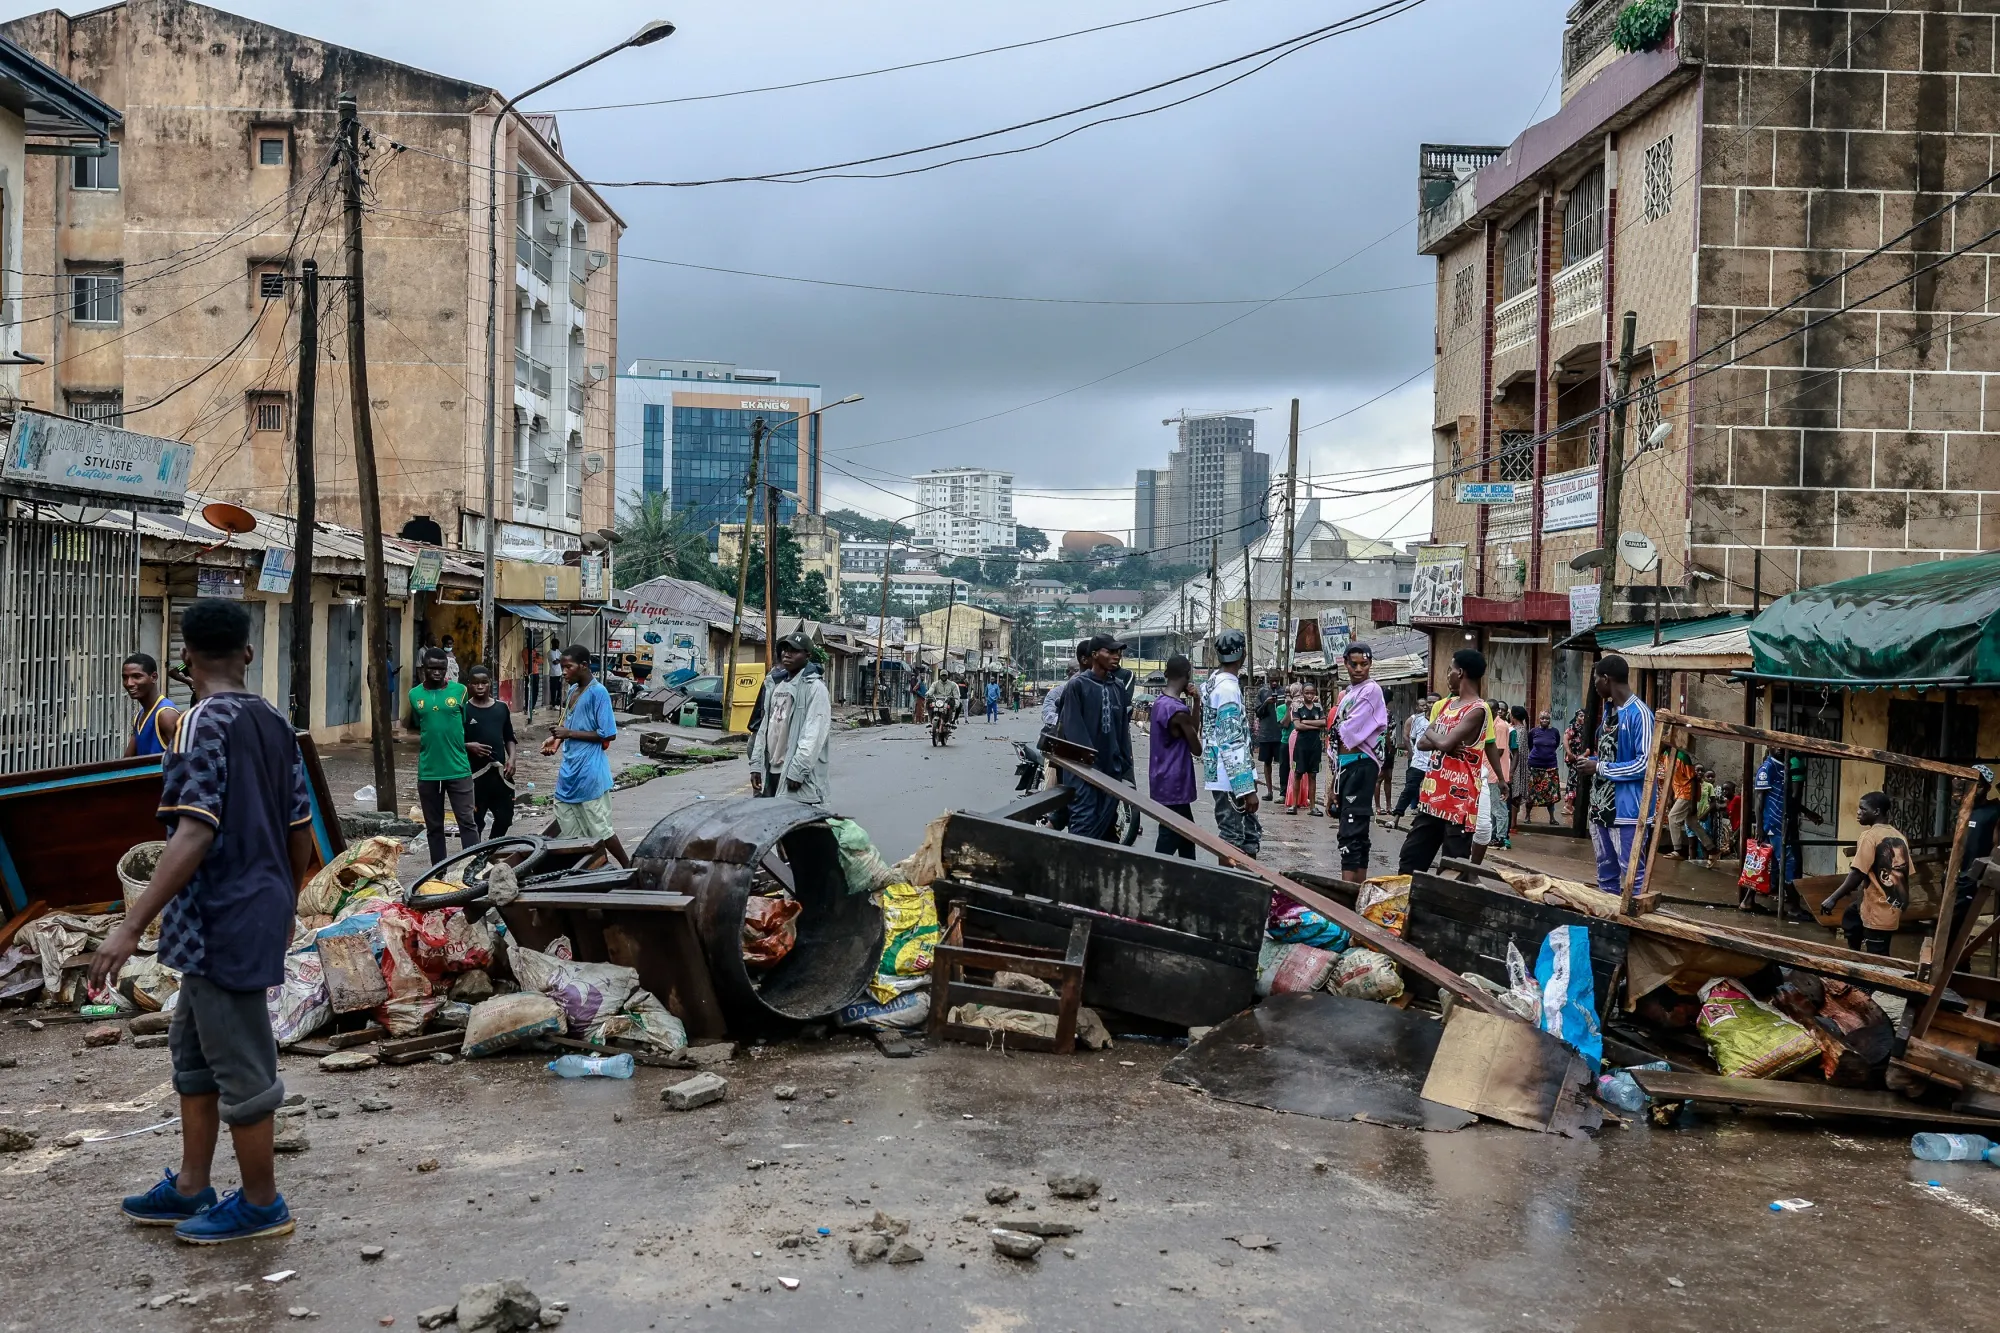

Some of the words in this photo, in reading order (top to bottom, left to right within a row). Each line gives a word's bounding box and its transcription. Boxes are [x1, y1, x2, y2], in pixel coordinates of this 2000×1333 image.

[741, 401, 779, 410] EKANG
[56, 423, 107, 454] NDIAYE
[108, 430, 163, 465] MANSOUR
[84, 456, 133, 471] STYLISTE
[66, 465, 113, 481] Couture
[117, 473, 144, 484] mixte
[1465, 484, 1488, 493] CABINET
[1491, 484, 1513, 493] MEDICAL
[1625, 540, 1647, 548] CANAL+
[620, 599, 669, 618] Afrique
[650, 617, 683, 626] Moderne
[1440, 768, 1469, 784] CHICAGO
